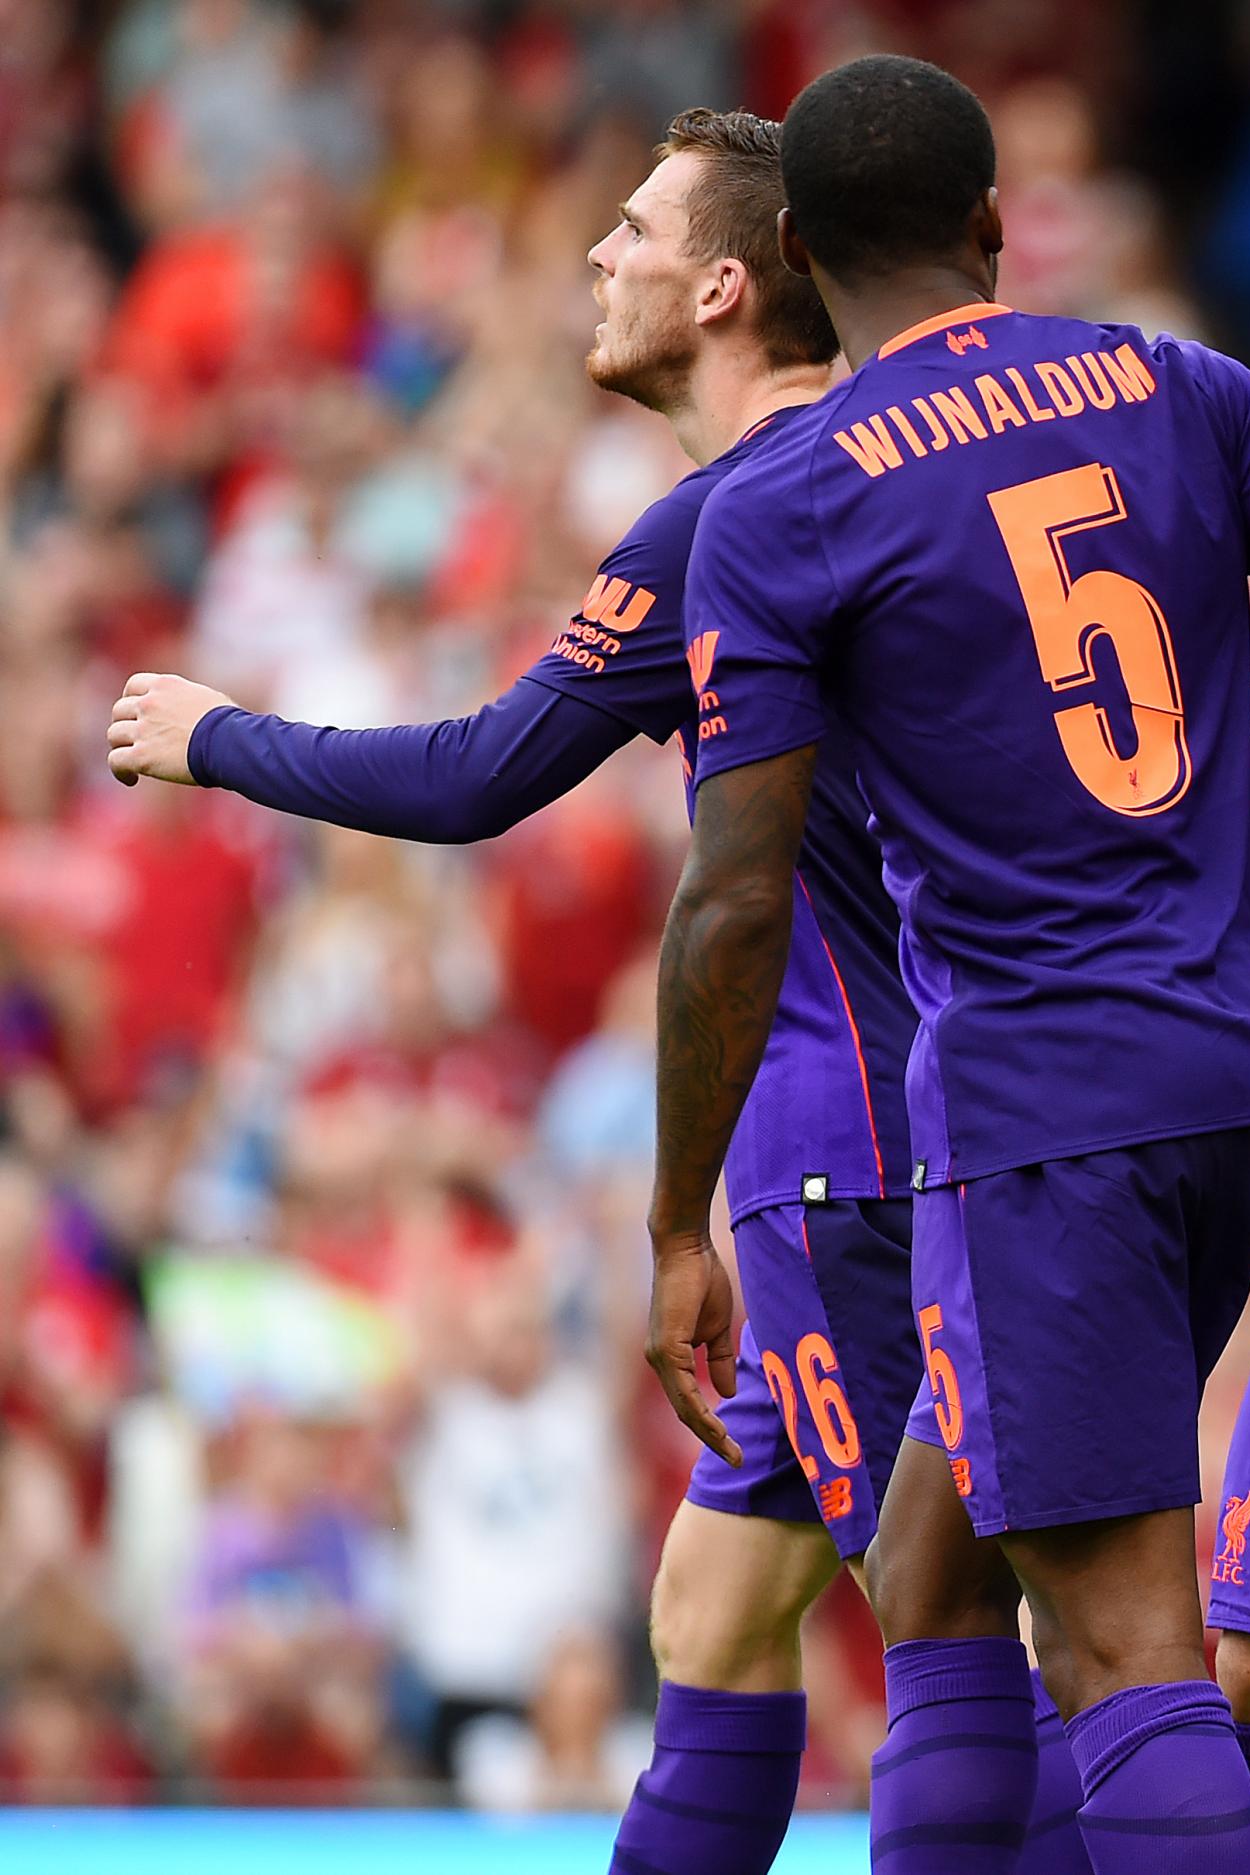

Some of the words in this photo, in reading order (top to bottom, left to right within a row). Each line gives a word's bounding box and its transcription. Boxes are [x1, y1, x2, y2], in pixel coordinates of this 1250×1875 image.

[832, 342, 1157, 478] WIJNALDUM
[987, 462, 1192, 817] 5
[761, 1332, 863, 1483] 26
[918, 1303, 964, 1451] 5
